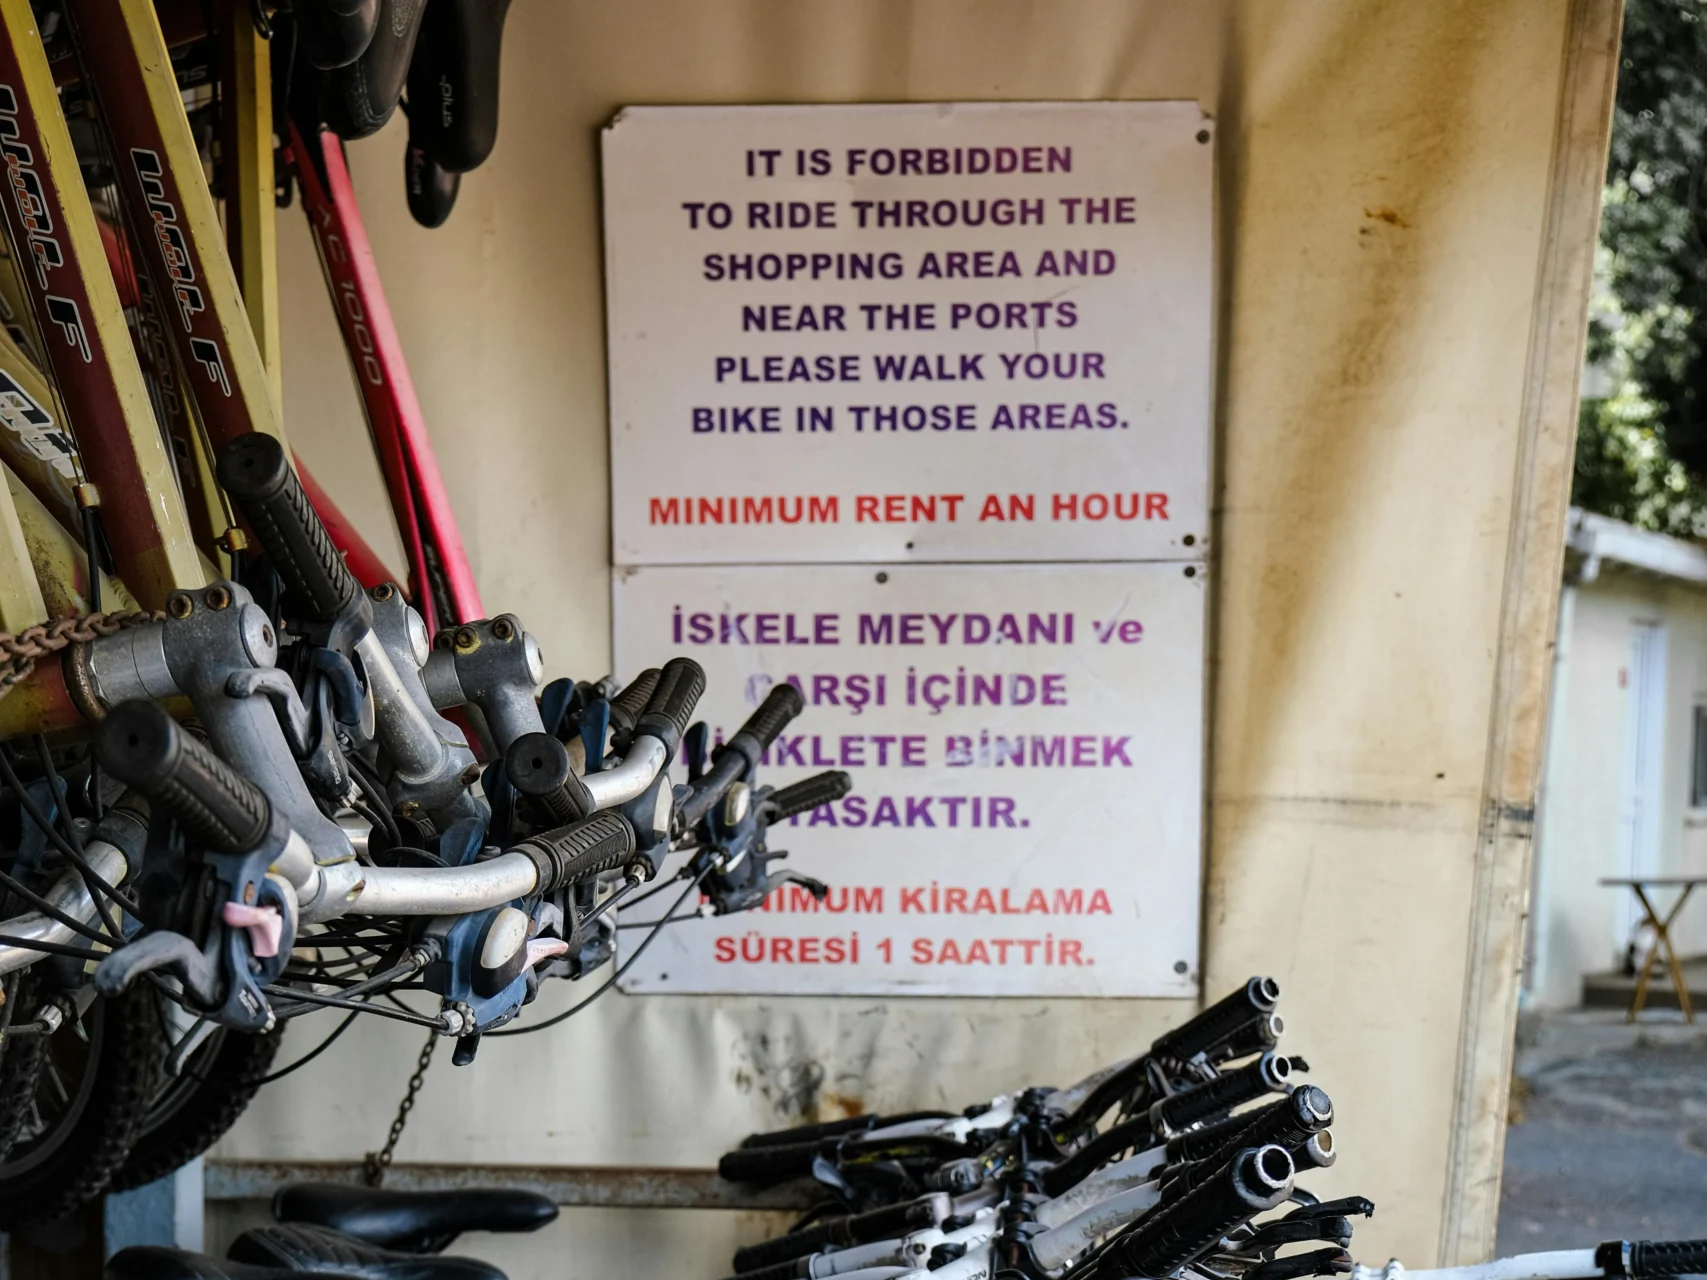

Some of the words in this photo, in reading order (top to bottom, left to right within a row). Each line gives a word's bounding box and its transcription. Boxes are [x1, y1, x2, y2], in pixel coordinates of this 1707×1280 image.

[746, 150, 782, 177] IT
[797, 149, 832, 176] IS
[847, 147, 1072, 176] FORBIDDEN
[682, 202, 732, 229] TO
[748, 202, 836, 229] RIDE
[851, 199, 1044, 228] THROUGH
[1059, 197, 1136, 224] THE
[703, 252, 903, 281] SHOPPING
[918, 251, 1021, 279] AREA
[1035, 249, 1116, 277] AND
[341, 279, 383, 386] 1000
[742, 305, 846, 332] NEAR
[859, 304, 935, 331] THE
[951, 301, 1077, 329] PORTS
[716, 356, 860, 383] PLEASE
[874, 354, 984, 381] WALK
[999, 352, 1105, 380] YOUR
[692, 407, 781, 433] BIKE
[797, 406, 833, 432] IN
[848, 405, 976, 432] THOSE
[990, 403, 1128, 430] AREAS.
[650, 496, 838, 525] MINIMUM
[856, 495, 964, 522] RENT
[979, 494, 1034, 521] AN
[1052, 493, 1168, 521] HOUR
[673, 605, 839, 644] İSKELE
[859, 613, 1073, 645] MEYDANI
[1092, 620, 1143, 644] ve
[906, 666, 1067, 715] İÇİNDE
[682, 728, 926, 766] KLETE
[945, 729, 1133, 767] BİNMEK
[327, 750, 342, 785] SHIANO
[900, 881, 1112, 915] KİRALAMA
[714, 931, 859, 964] SÜRESİ
[876, 938, 892, 964] 1
[910, 931, 1094, 966] SAATTİR.
